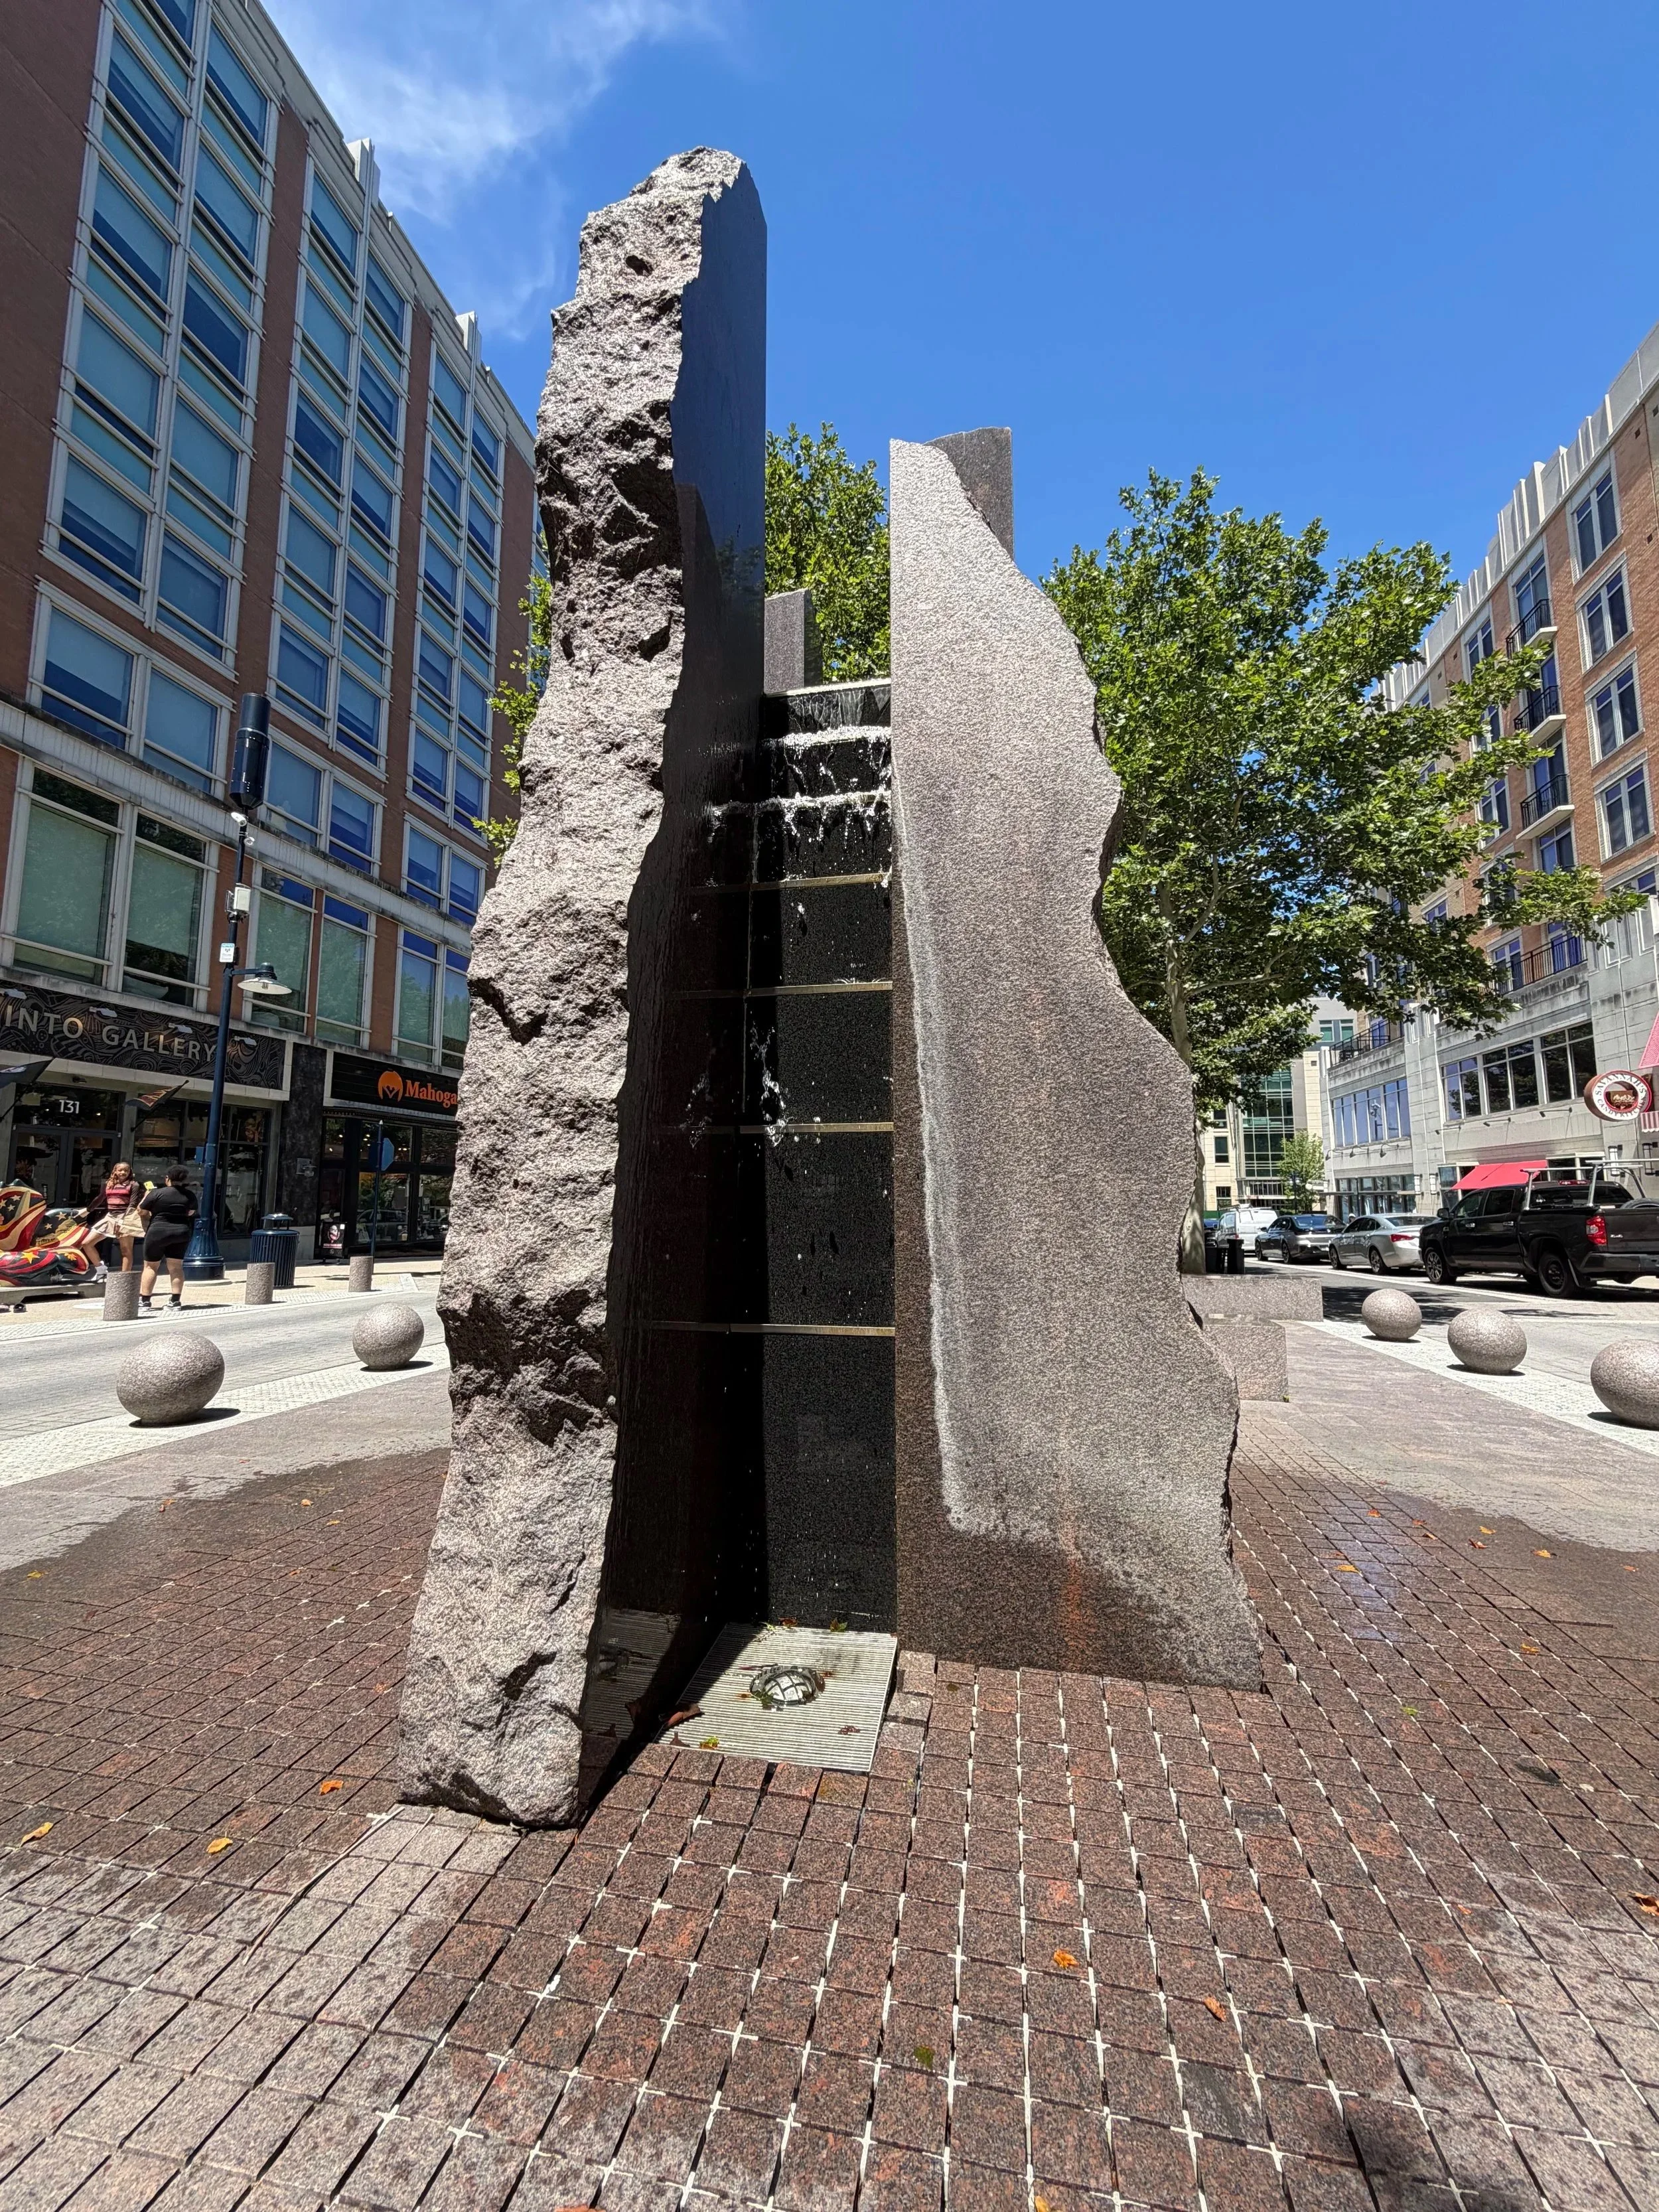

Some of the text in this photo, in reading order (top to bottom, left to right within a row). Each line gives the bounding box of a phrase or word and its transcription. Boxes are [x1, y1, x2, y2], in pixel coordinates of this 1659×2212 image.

[5, 1005, 216, 1062] INTO GALLERY
[58, 1099, 80, 1114] 131
